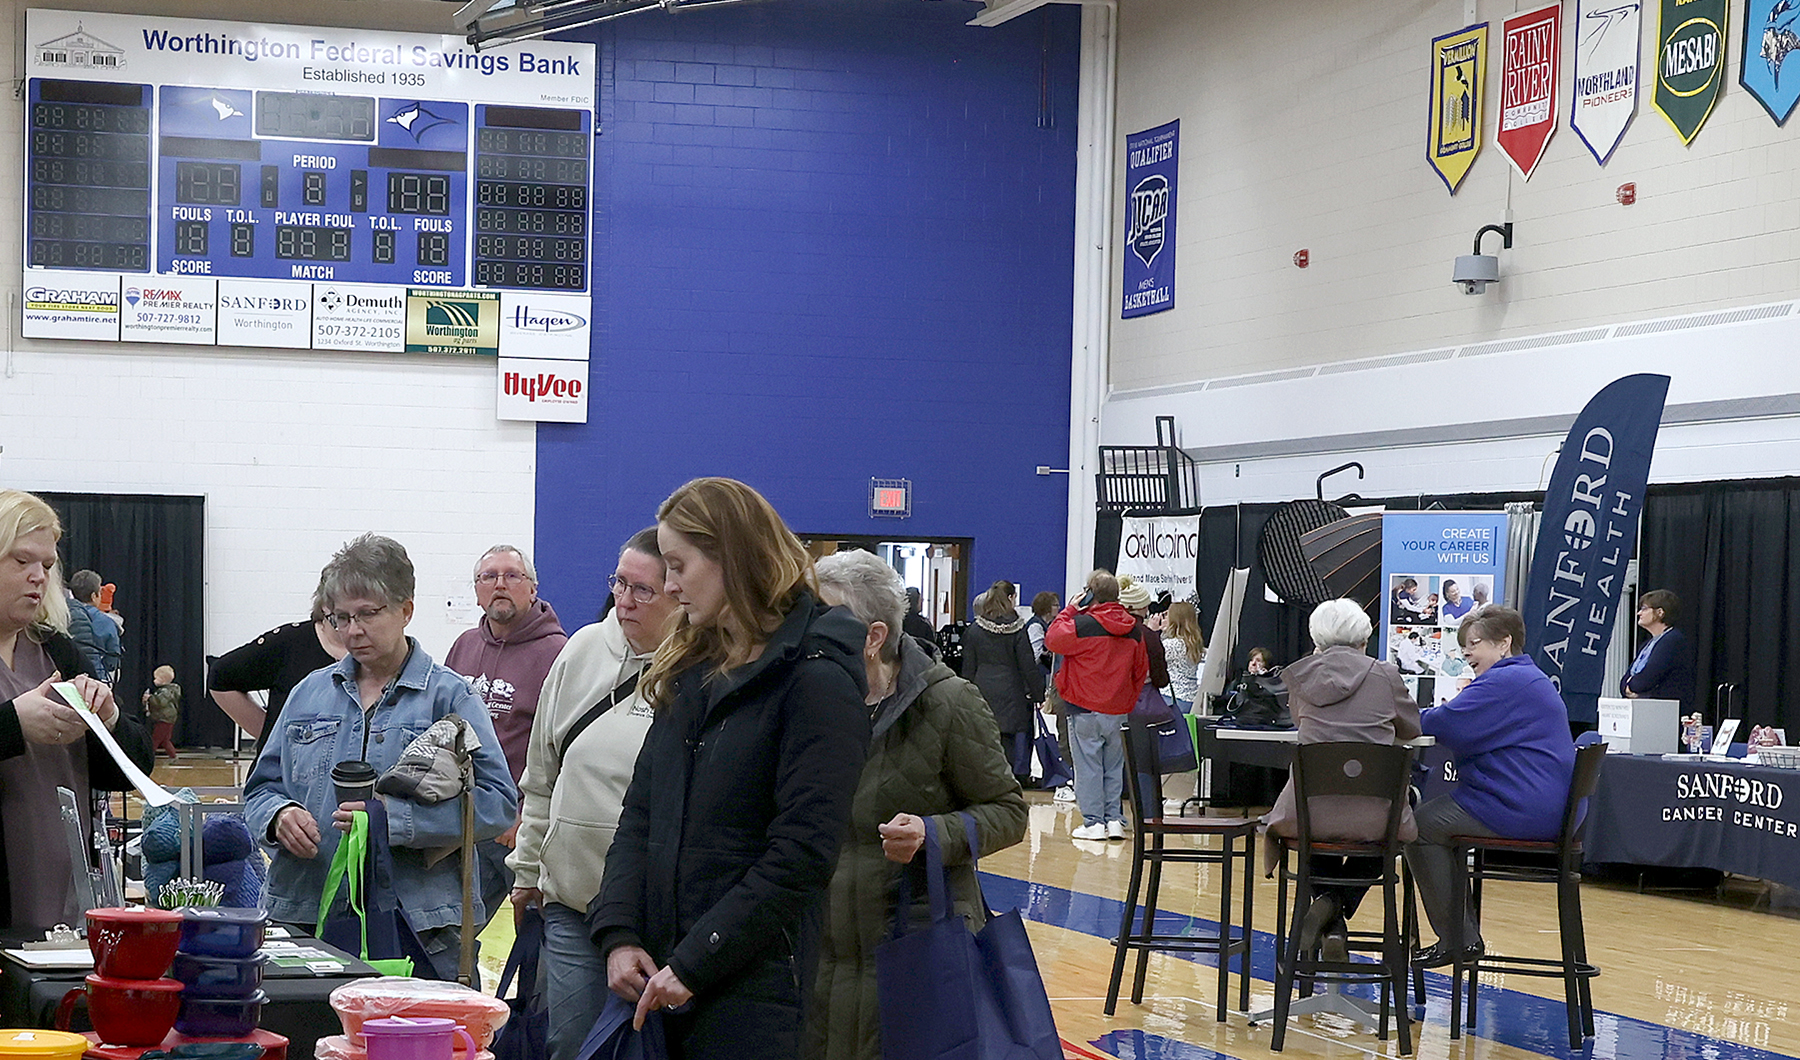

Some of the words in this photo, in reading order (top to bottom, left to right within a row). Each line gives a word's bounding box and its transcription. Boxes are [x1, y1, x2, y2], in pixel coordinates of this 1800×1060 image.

[143, 29, 300, 60] Worthington
[310, 40, 401, 66] Federal
[411, 43, 509, 74] Savings
[518, 52, 580, 77] Bank
[1508, 25, 1550, 70] RAINY
[1665, 32, 1717, 78] MESABI
[302, 67, 385, 86] Established
[390, 71, 426, 87] 1935
[1506, 63, 1550, 107] RIVER
[1577, 66, 1634, 97] NORTHLAND
[540, 94, 569, 103] Member
[1582, 87, 1633, 109] PIONEERS
[293, 154, 337, 171] PERIOD
[1130, 140, 1173, 170] QUALIFIER
[172, 206, 212, 222] FOULS
[226, 209, 260, 225] T.O.L.
[275, 211, 321, 228] PLAYER
[324, 214, 356, 229] FOUL
[369, 216, 402, 232] T.O.L.
[414, 218, 453, 233] FOULS
[171, 259, 212, 275] SCORE
[291, 264, 335, 280] MATCH
[413, 270, 452, 285] SCORE
[26, 287, 118, 306] GRAHAM
[143, 289, 182, 301] RE/MAX
[346, 294, 403, 309] Demuth
[1124, 286, 1170, 310] BASKETBALL
[143, 300, 181, 309] PREMIER
[183, 302, 214, 310] REALTY
[221, 295, 307, 312] SANFORD
[26, 313, 117, 324] www.grahamtire.net
[137, 312, 201, 325] 507-727-9812
[234, 318, 293, 332] Worthington
[515, 305, 574, 332] Hagen
[318, 325, 401, 338] 507-372-2105
[426, 325, 479, 338] Worthington
[364, 341, 401, 349] Worthington
[880, 490, 902, 508] EXIT
[1442, 528, 1490, 540] CREATE
[1402, 541, 1436, 551] YOUR
[1439, 541, 1490, 552] CAREER
[1437, 553, 1470, 564] WITH
[1472, 553, 1490, 564] US
[1581, 490, 1632, 656] HEALTH
[1677, 773, 1784, 810] SANFORD
[1662, 806, 1724, 822] CANCER
[1733, 810, 1798, 838] CENTER
